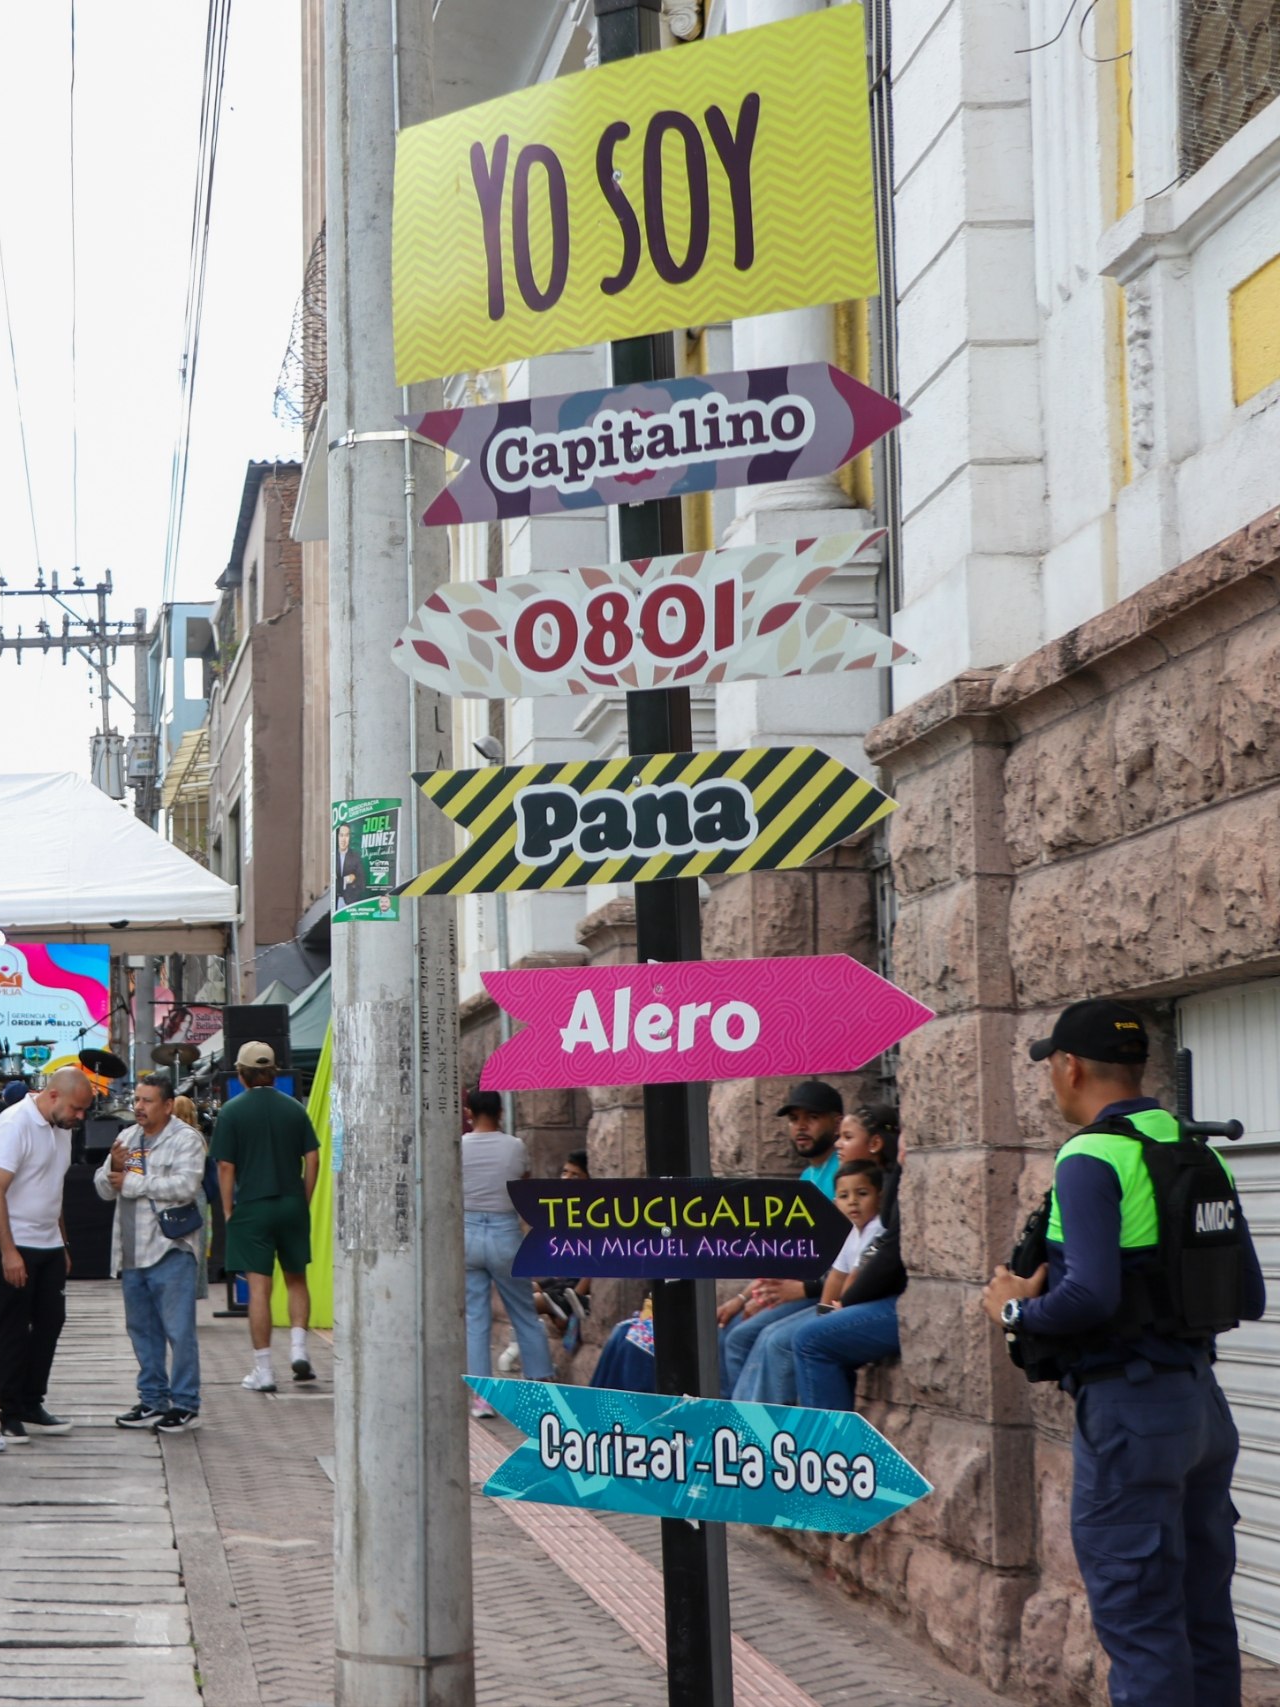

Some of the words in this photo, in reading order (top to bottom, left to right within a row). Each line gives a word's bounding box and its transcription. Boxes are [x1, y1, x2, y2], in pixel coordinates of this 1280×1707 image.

[470, 134, 569, 321] YO
[596, 92, 760, 296] SOY
[494, 403, 807, 485] Capitalino
[513, 578, 735, 674] 0801
[362, 815, 391, 834] JOEL
[519, 784, 752, 860] Pana
[372, 872, 386, 884] 7
[11, 1019, 42, 1027] ORDEN
[560, 987, 761, 1054] Alero
[538, 1195, 816, 1229] TEGUCIGALPA
[1195, 1199, 1235, 1233] AMDC
[549, 1236, 592, 1257] SAN
[601, 1236, 689, 1258] MIGUEL
[539, 1413, 687, 1482] Carrizal
[771, 1430, 877, 1500] Sosa
